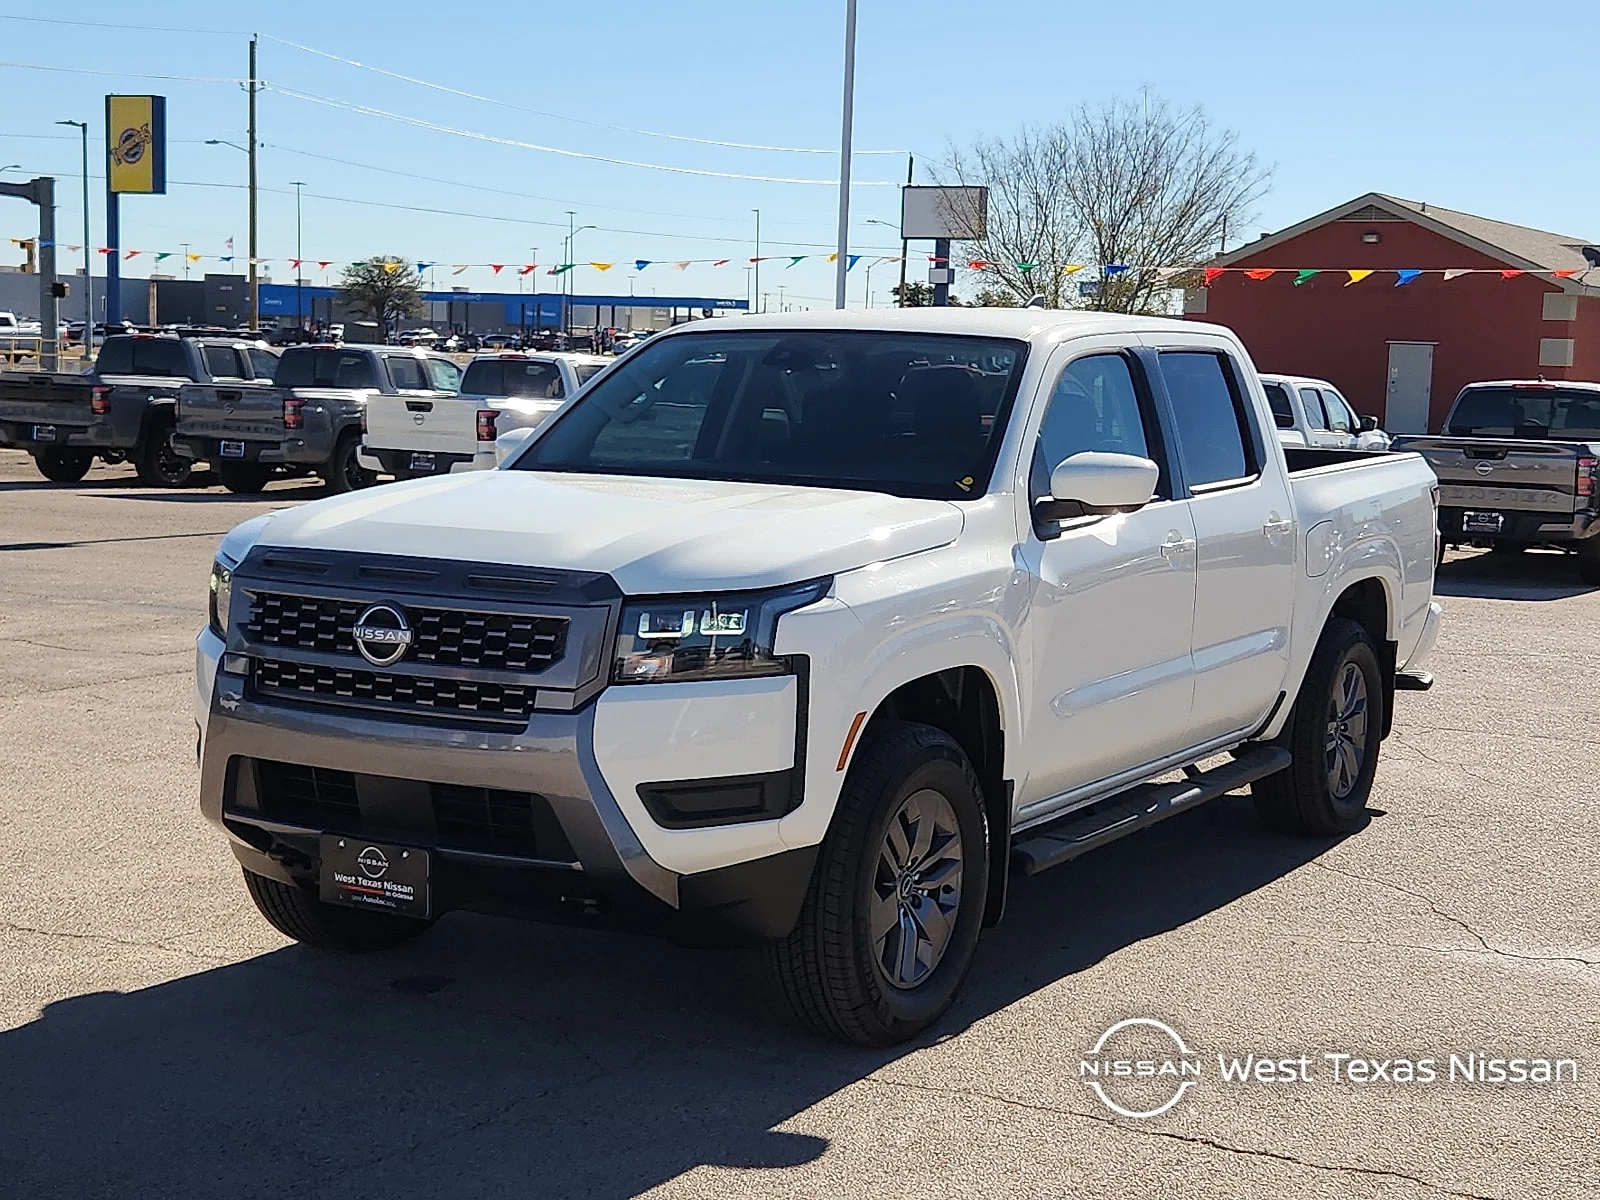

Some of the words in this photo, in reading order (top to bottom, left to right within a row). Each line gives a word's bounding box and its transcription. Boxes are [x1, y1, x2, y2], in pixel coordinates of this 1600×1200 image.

[352, 627, 411, 642] NISSAN
[357, 857, 389, 867] NISSAN
[334, 872, 356, 884] West
[357, 877, 382, 888] Texas
[384, 881, 414, 893] Nissan
